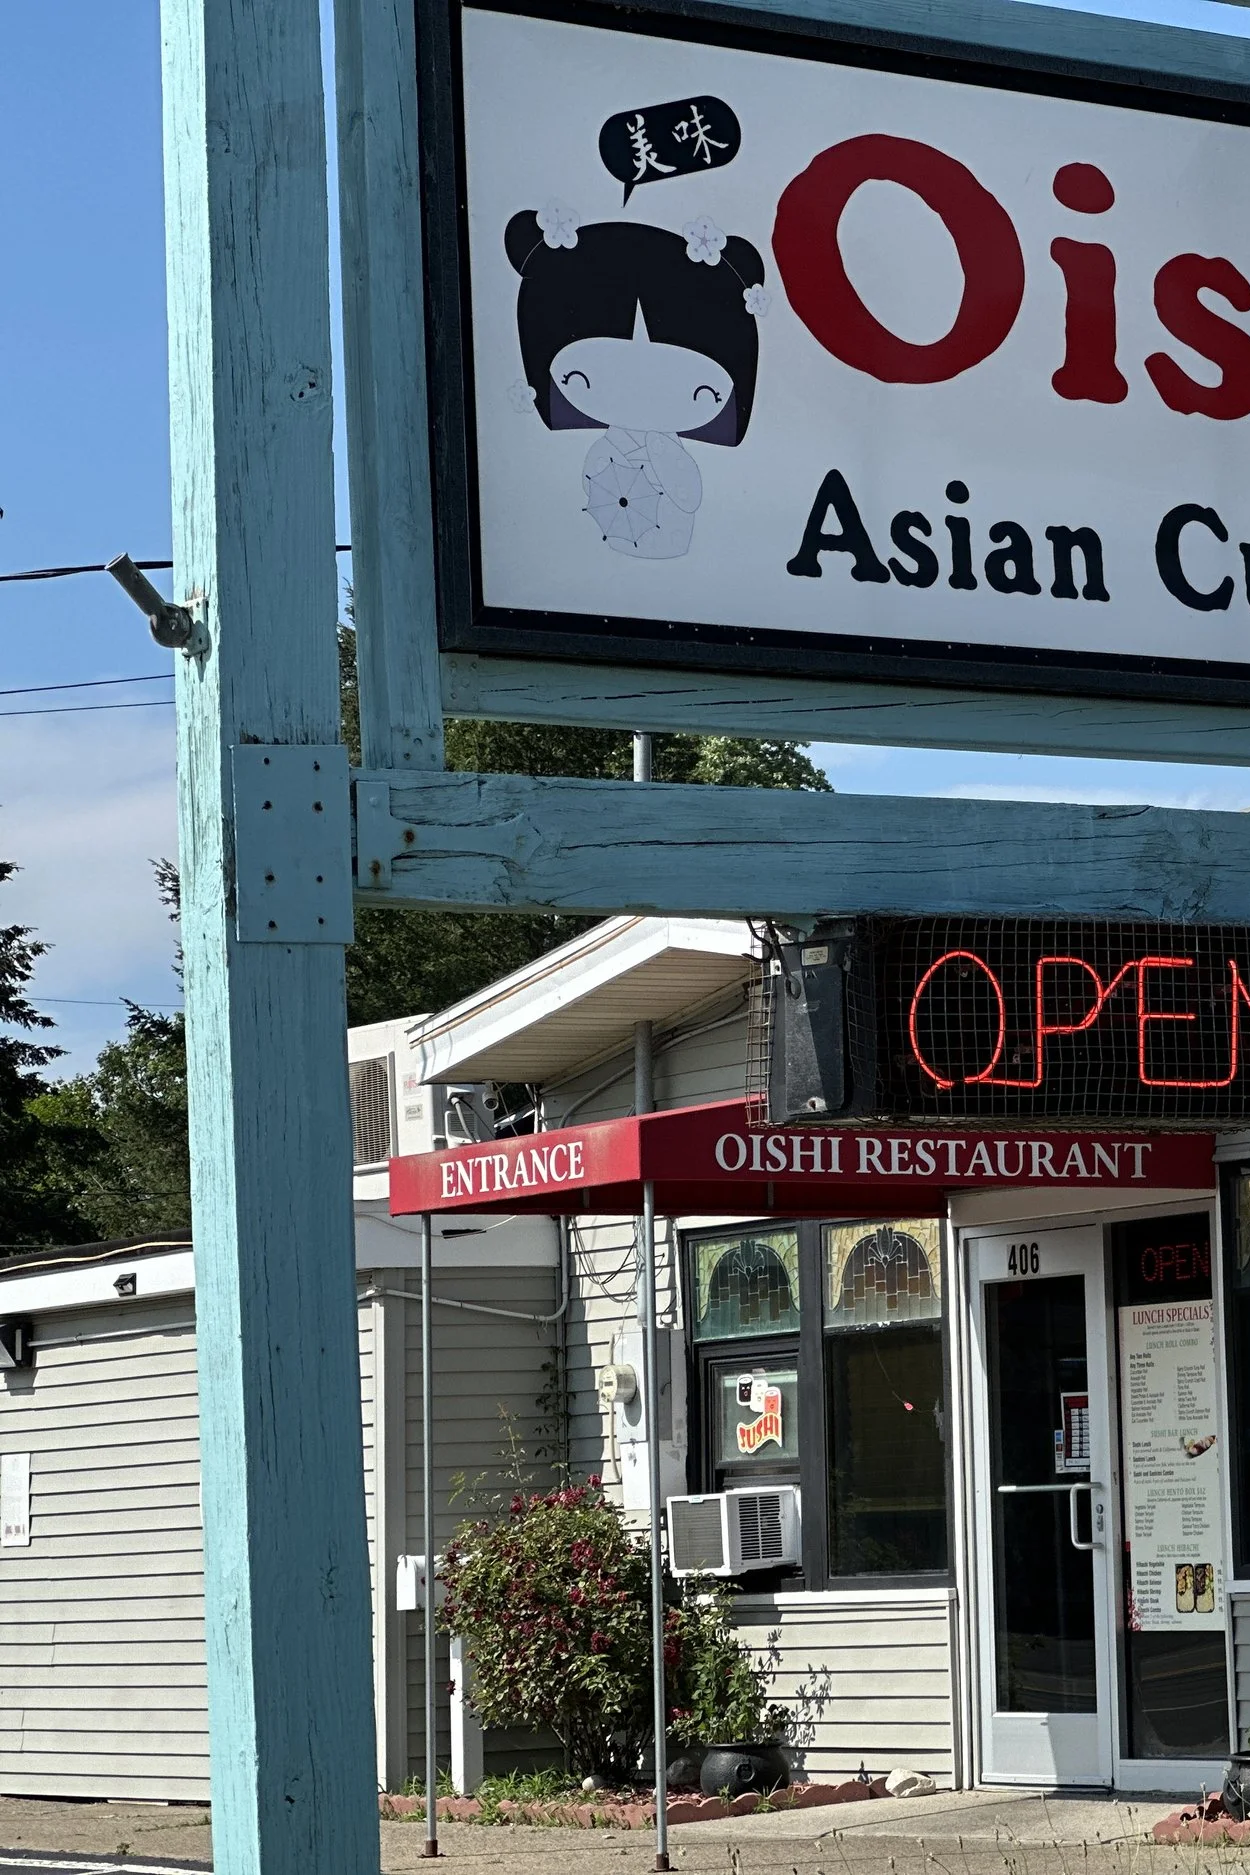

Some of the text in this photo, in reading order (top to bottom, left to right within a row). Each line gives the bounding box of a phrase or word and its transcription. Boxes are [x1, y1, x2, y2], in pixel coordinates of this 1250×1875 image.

[625, 104, 729, 182] 美味
[786, 468, 1111, 603] Asian
[440, 1141, 585, 1198] ENTRANCE
[714, 1132, 1152, 1179] OISHI RESTAURANT
[1008, 1242, 1040, 1276] 406
[1141, 1241, 1210, 1282] OPEN
[1133, 1305, 1210, 1325] LUNCH SPECIALS
[1146, 1339, 1198, 1350] LUNCH ROLL COMBO
[738, 1414, 780, 1449] SUSHI
[1151, 1428, 1198, 1438] SUSHI BAR LUNCH
